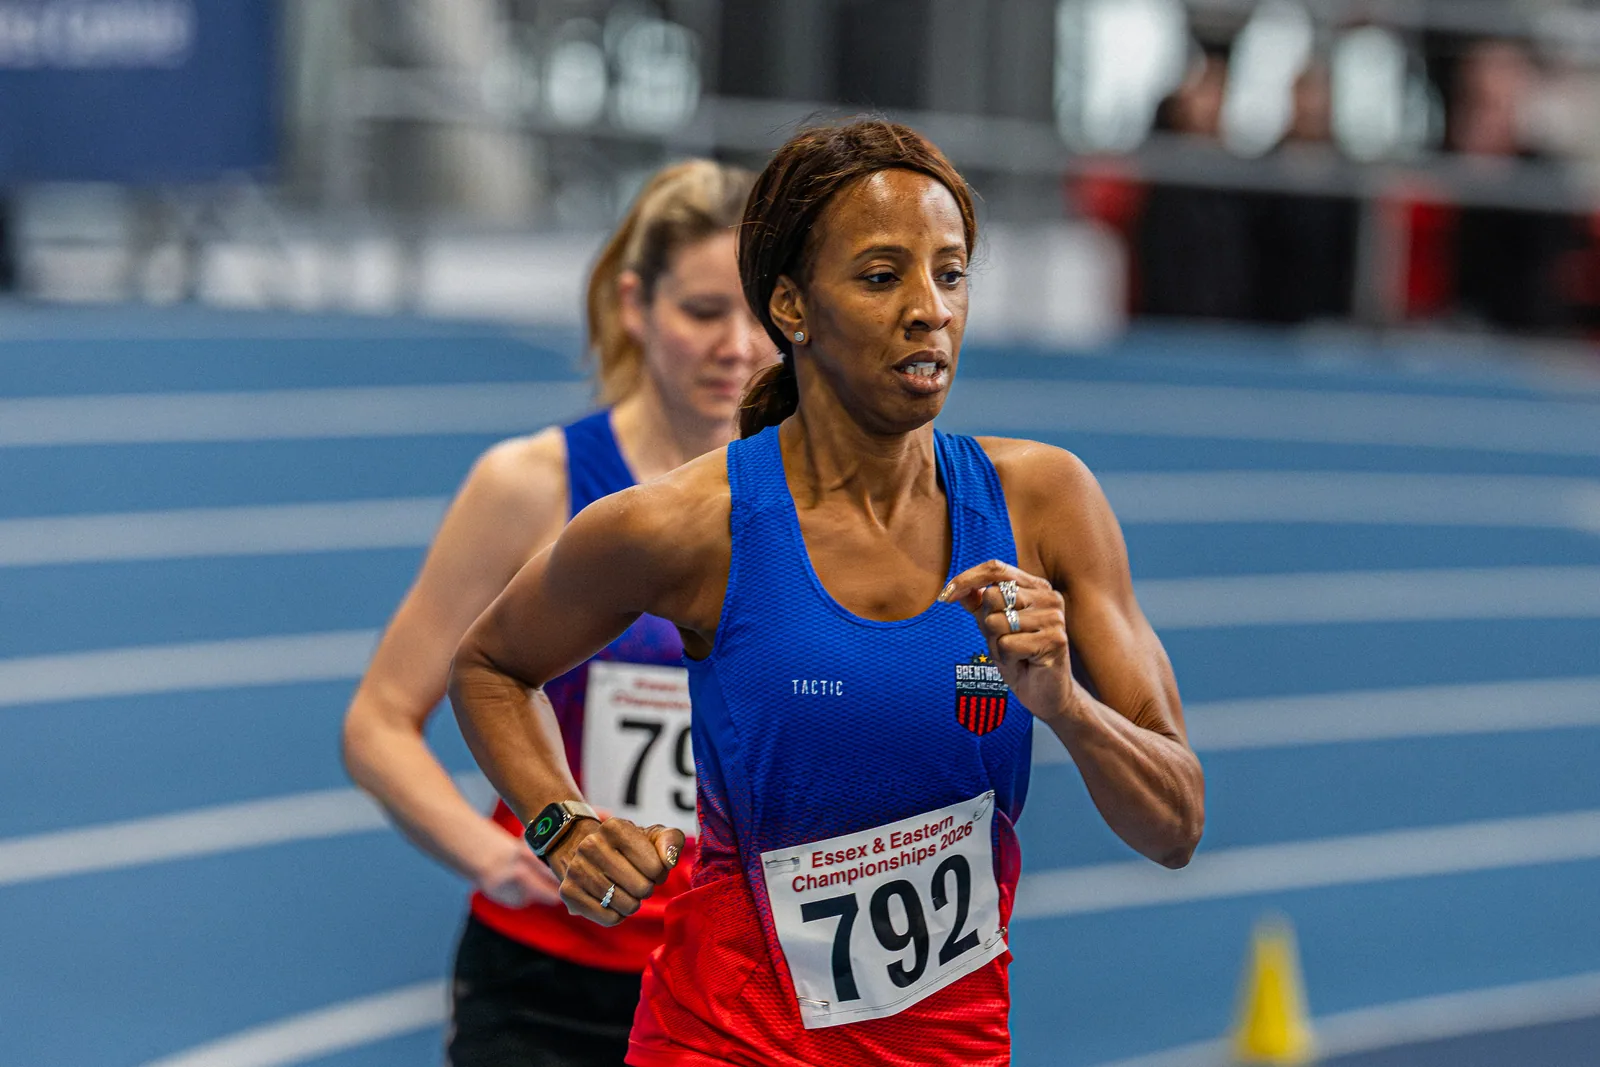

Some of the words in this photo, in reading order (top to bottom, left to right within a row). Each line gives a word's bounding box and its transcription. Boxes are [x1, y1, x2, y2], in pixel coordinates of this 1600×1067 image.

[791, 679, 843, 696] TACTIC
[792, 843, 937, 893] Championships
[940, 820, 974, 851] 2026
[811, 847, 868, 869] Essex
[873, 837, 886, 855] &
[890, 815, 954, 850] Eastern
[799, 854, 981, 1003] 792
